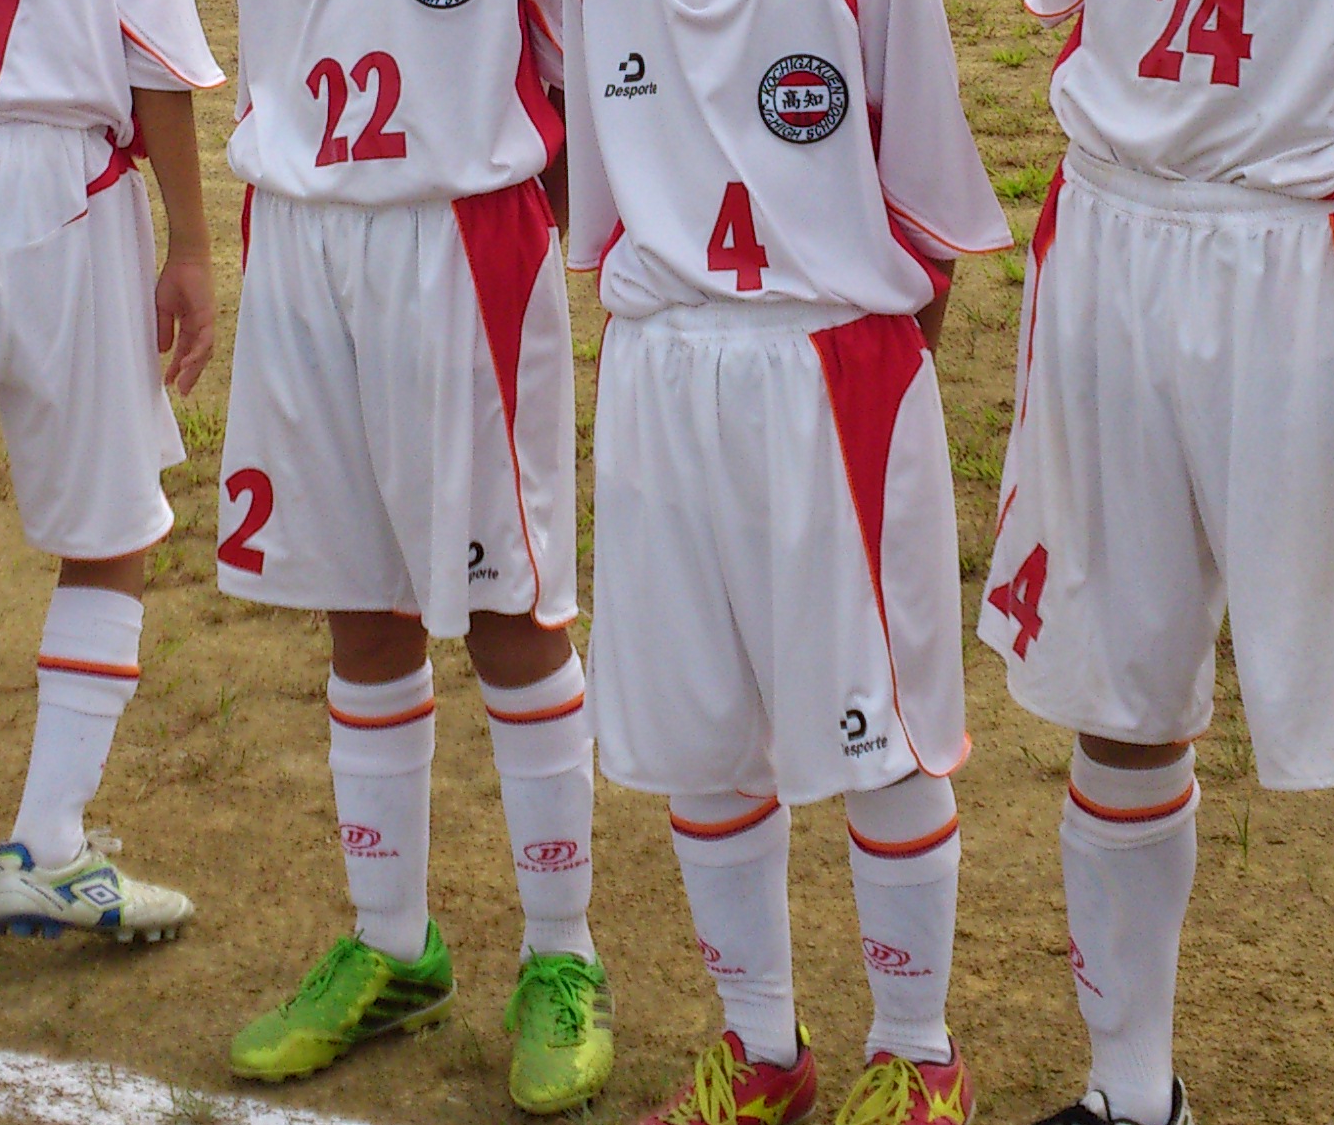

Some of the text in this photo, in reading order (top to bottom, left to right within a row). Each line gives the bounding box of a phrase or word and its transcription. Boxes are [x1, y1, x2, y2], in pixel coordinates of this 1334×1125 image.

[305, 50, 407, 168] 22
[604, 81, 657, 100] Desporte
[762, 58, 844, 98] KOCHIGAKUEN
[807, 101, 843, 140] SCHOOL
[706, 180, 770, 292] 4
[218, 467, 274, 576] 2
[987, 542, 1049, 663] 4
[841, 736, 889, 759] esporte
